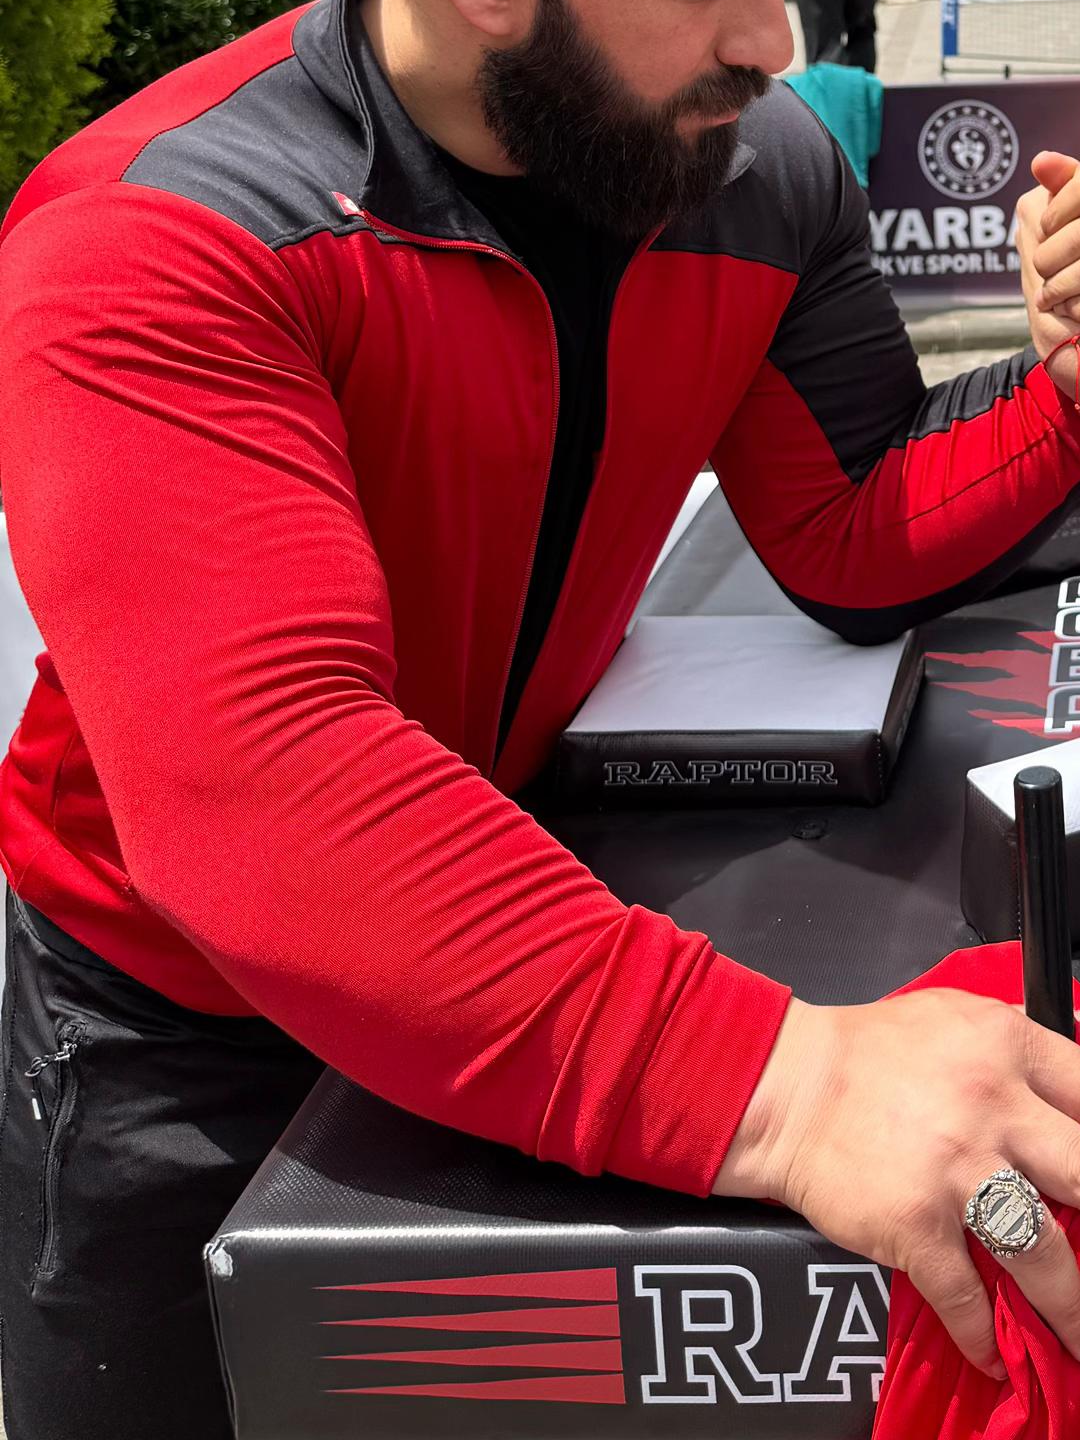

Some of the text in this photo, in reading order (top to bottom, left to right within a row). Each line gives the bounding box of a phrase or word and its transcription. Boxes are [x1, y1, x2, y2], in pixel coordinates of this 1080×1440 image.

[869, 205, 1019, 252] YARB
[895, 254, 925, 276] VE
[925, 253, 983, 275] SPOR
[604, 760, 838, 786] RAPTOR
